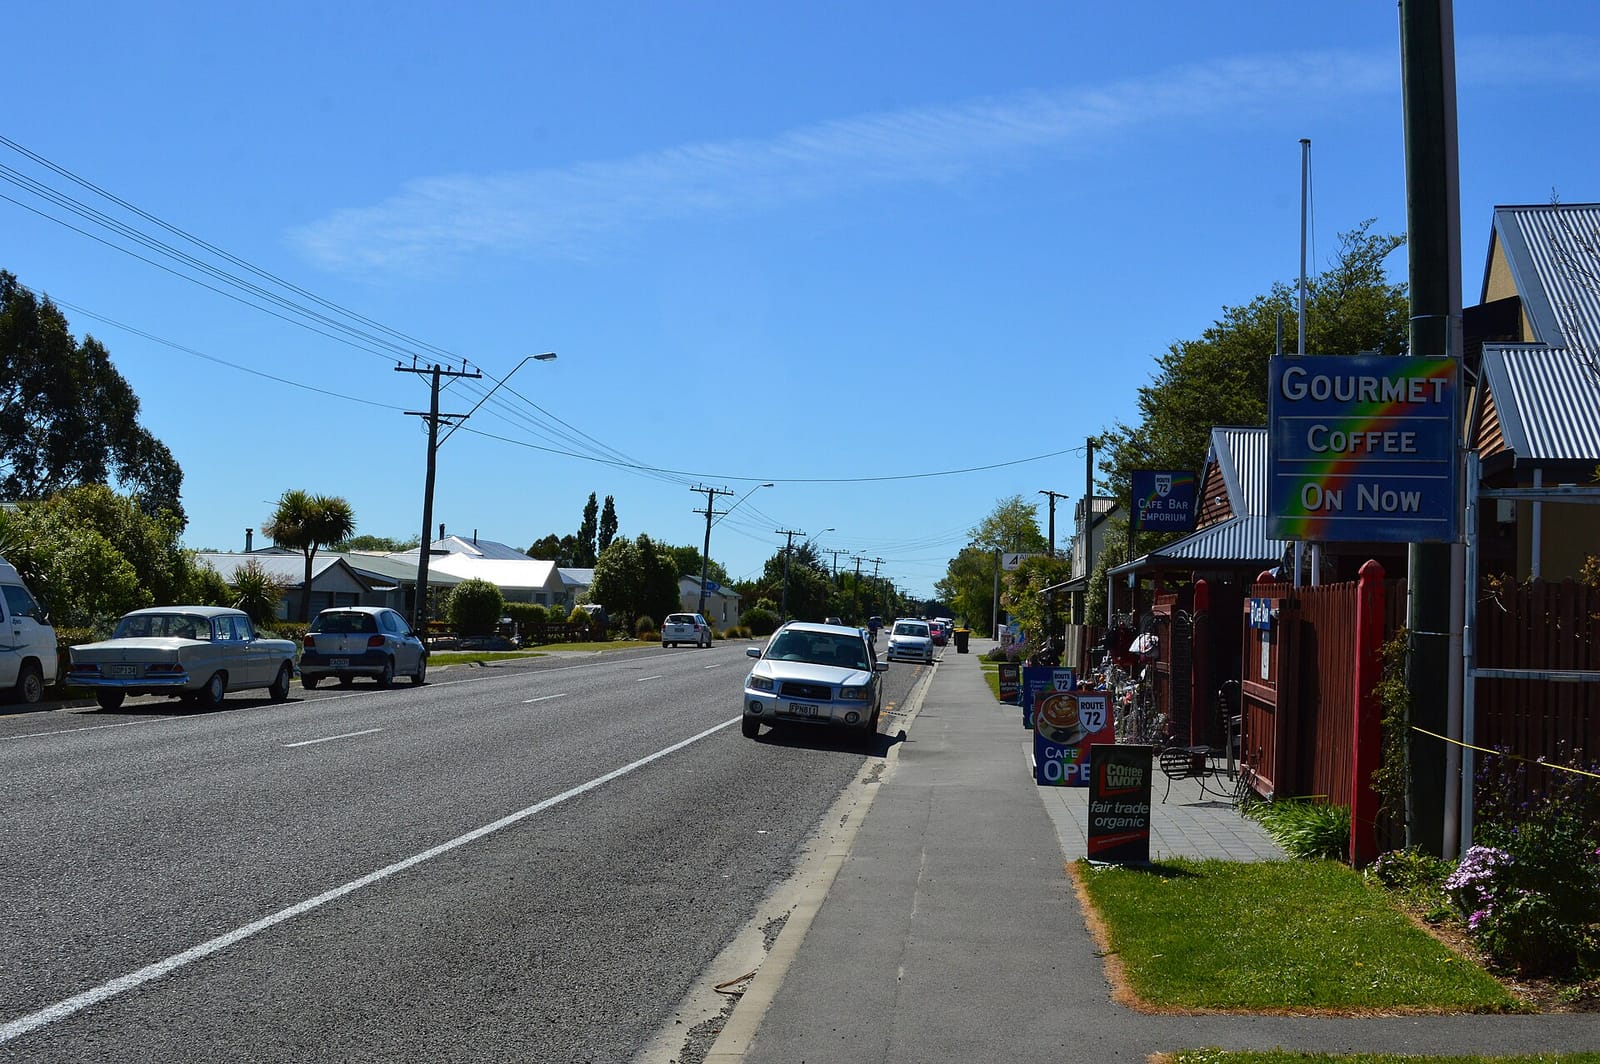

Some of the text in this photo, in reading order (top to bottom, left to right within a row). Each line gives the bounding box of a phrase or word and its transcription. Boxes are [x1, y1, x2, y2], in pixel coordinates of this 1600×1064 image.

[1281, 366, 1448, 403] GOURMET
[1307, 424, 1417, 453] COFFEE
[1158, 483, 1168, 493] 72
[1301, 482, 1422, 512] ON NOW
[1138, 498, 1188, 510] CAFE BAR
[1140, 510, 1186, 521] EMPORIUM
[1056, 680, 1068, 690] 72
[1080, 701, 1104, 710] ROUTE
[1085, 711, 1101, 726] 72
[1045, 746, 1079, 759] CAFE
[1044, 760, 1090, 781] OPE
[1090, 801, 1149, 814] fair trade
[1095, 815, 1145, 829] organic
